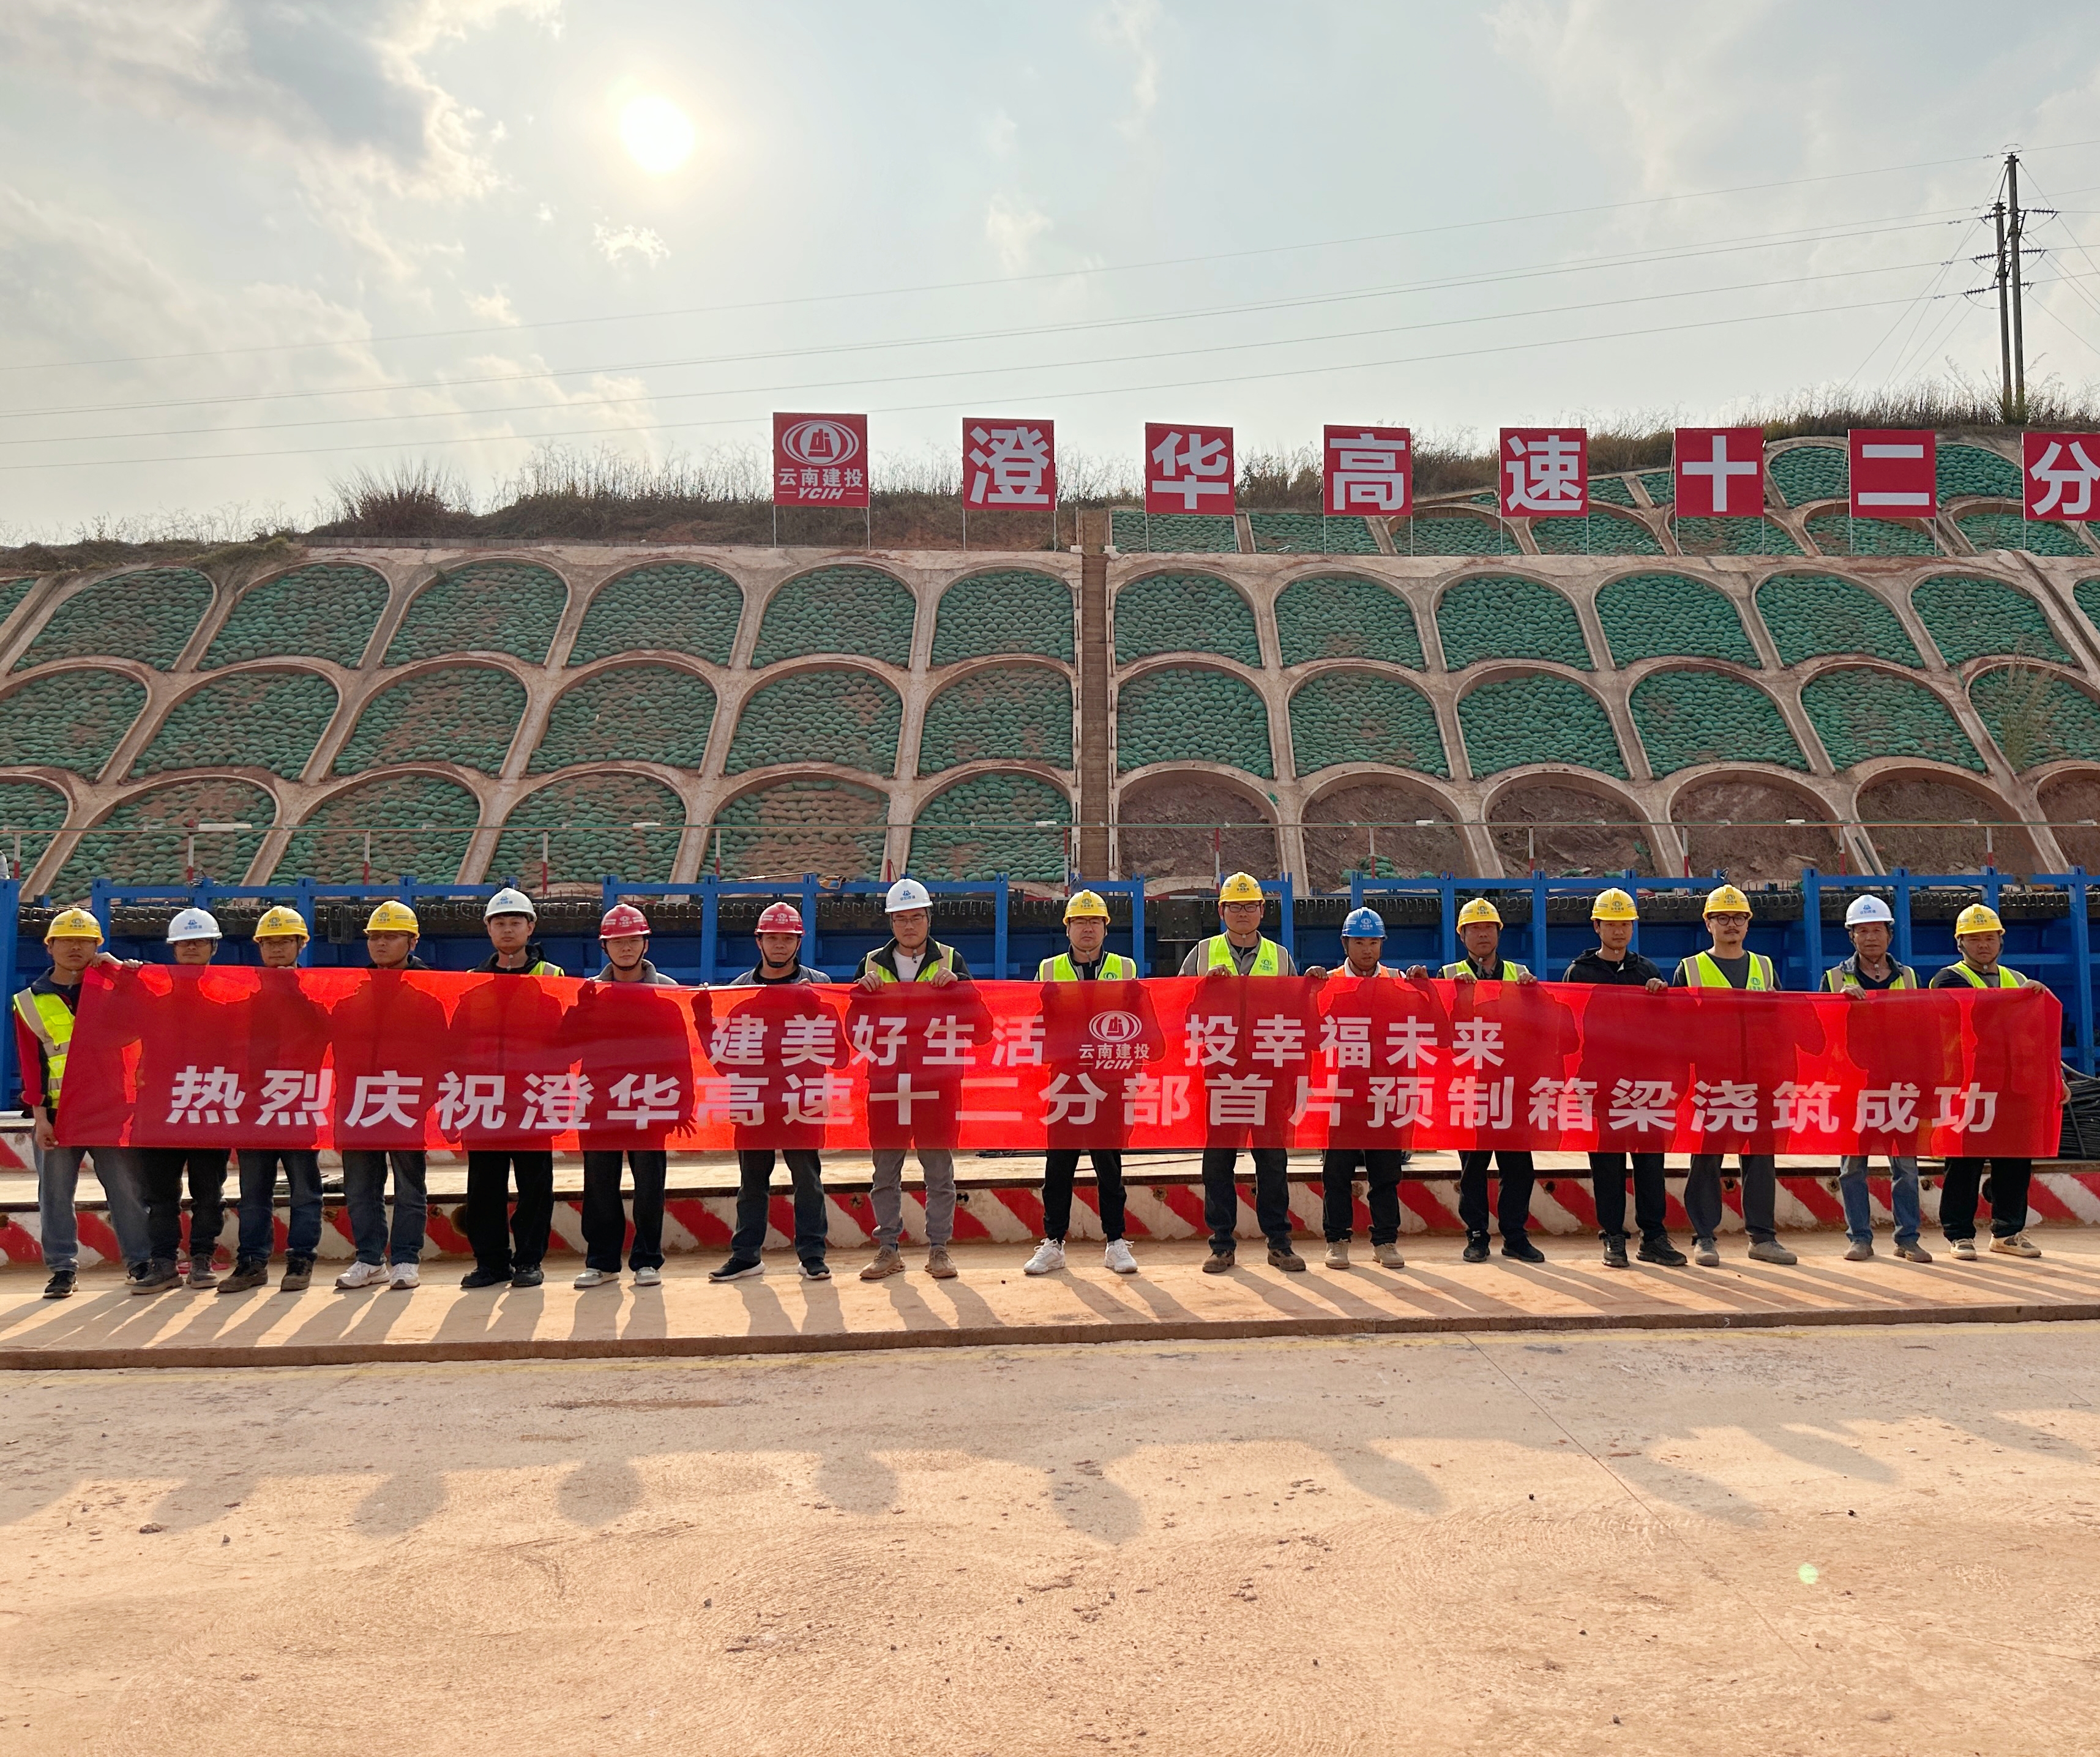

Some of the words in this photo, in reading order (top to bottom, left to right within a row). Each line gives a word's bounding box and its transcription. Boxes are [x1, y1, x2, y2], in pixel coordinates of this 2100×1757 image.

[779, 467, 863, 488] 云南建投
[968, 426, 1050, 504] 澄
[1151, 431, 1229, 510] 华
[1329, 432, 1406, 510] 高
[1506, 435, 1583, 512] 速
[1682, 435, 1757, 512] 十
[1858, 444, 1930, 505] 二
[2029, 441, 2100, 516] 分
[798, 487, 844, 499] YCIH
[708, 1013, 1046, 1067] 建美好生活
[1184, 1013, 1506, 1070] 投幸福未来
[1078, 1043, 1150, 1059] 云南建投
[1095, 1059, 1134, 1070] YCIH
[166, 1065, 1998, 1134] 热烈庆祝澄华高速十二分部首片预制箱梁浇筑成功
